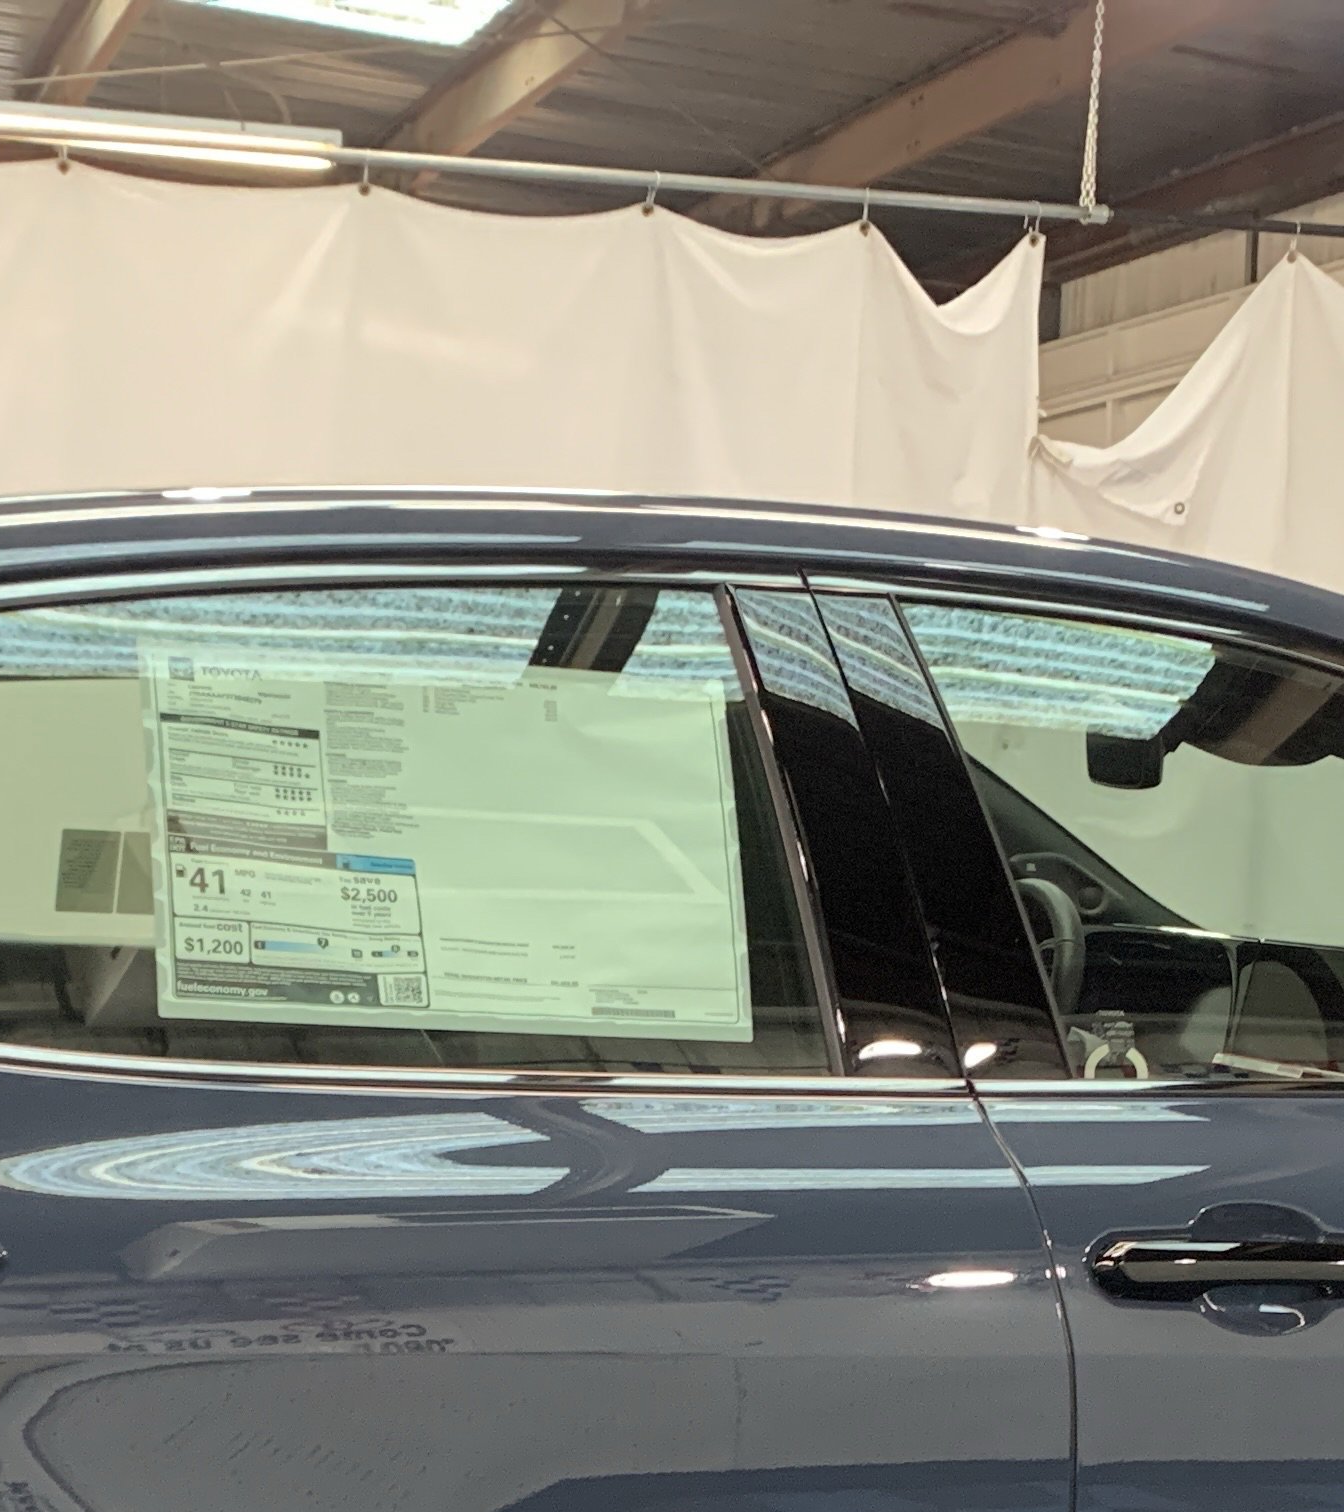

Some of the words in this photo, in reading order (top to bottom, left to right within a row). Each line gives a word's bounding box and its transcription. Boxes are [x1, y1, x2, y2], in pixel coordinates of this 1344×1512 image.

[201, 666, 262, 681] TOYOTA
[190, 842, 210, 852] Fuel
[211, 843, 251, 857] Economy
[252, 849, 269, 858] and
[234, 868, 256, 878] MPG
[189, 867, 226, 896] 41
[353, 876, 381, 885] save
[239, 889, 252, 898] 42
[261, 891, 272, 899] 41
[340, 887, 398, 904] $2,500
[193, 904, 208, 912] 2.4
[216, 922, 243, 933] cost
[184, 938, 243, 956] $1,200
[177, 980, 269, 996] fueleconomy.gov
